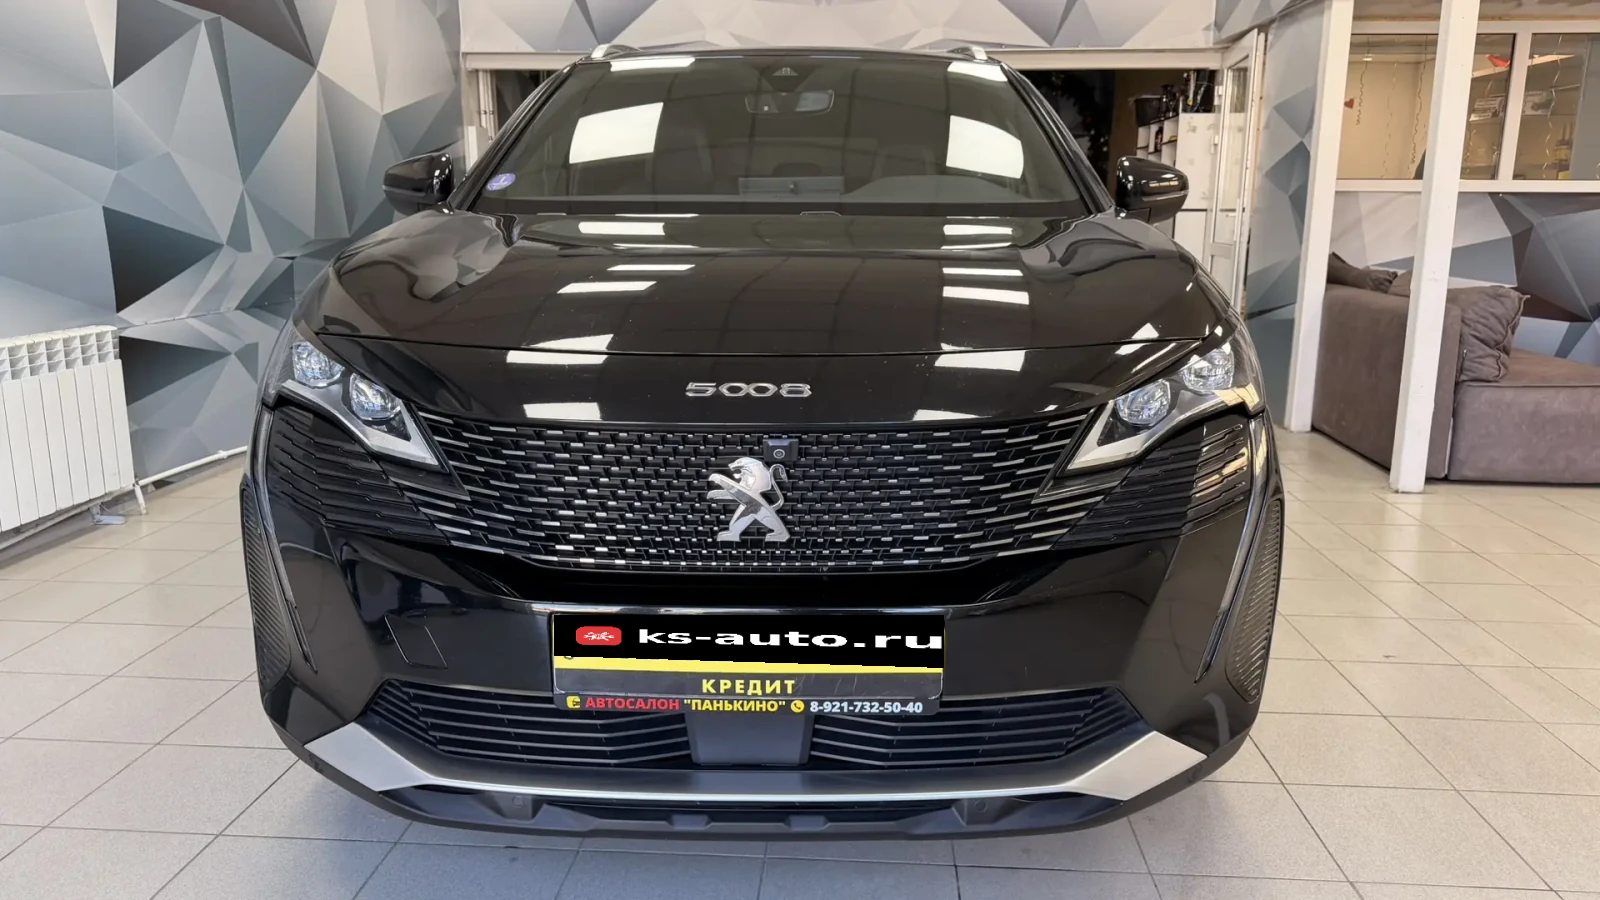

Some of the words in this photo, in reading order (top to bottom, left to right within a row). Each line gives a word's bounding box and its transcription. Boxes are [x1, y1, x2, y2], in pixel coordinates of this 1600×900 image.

[685, 382, 812, 397] 5008
[702, 679, 796, 696] КРЕДИТ
[585, 697, 680, 710] АВТОСАЛОН
[684, 699, 786, 712] "ПАНЬКИНО"
[809, 701, 923, 713] 8-921-732-50-40
